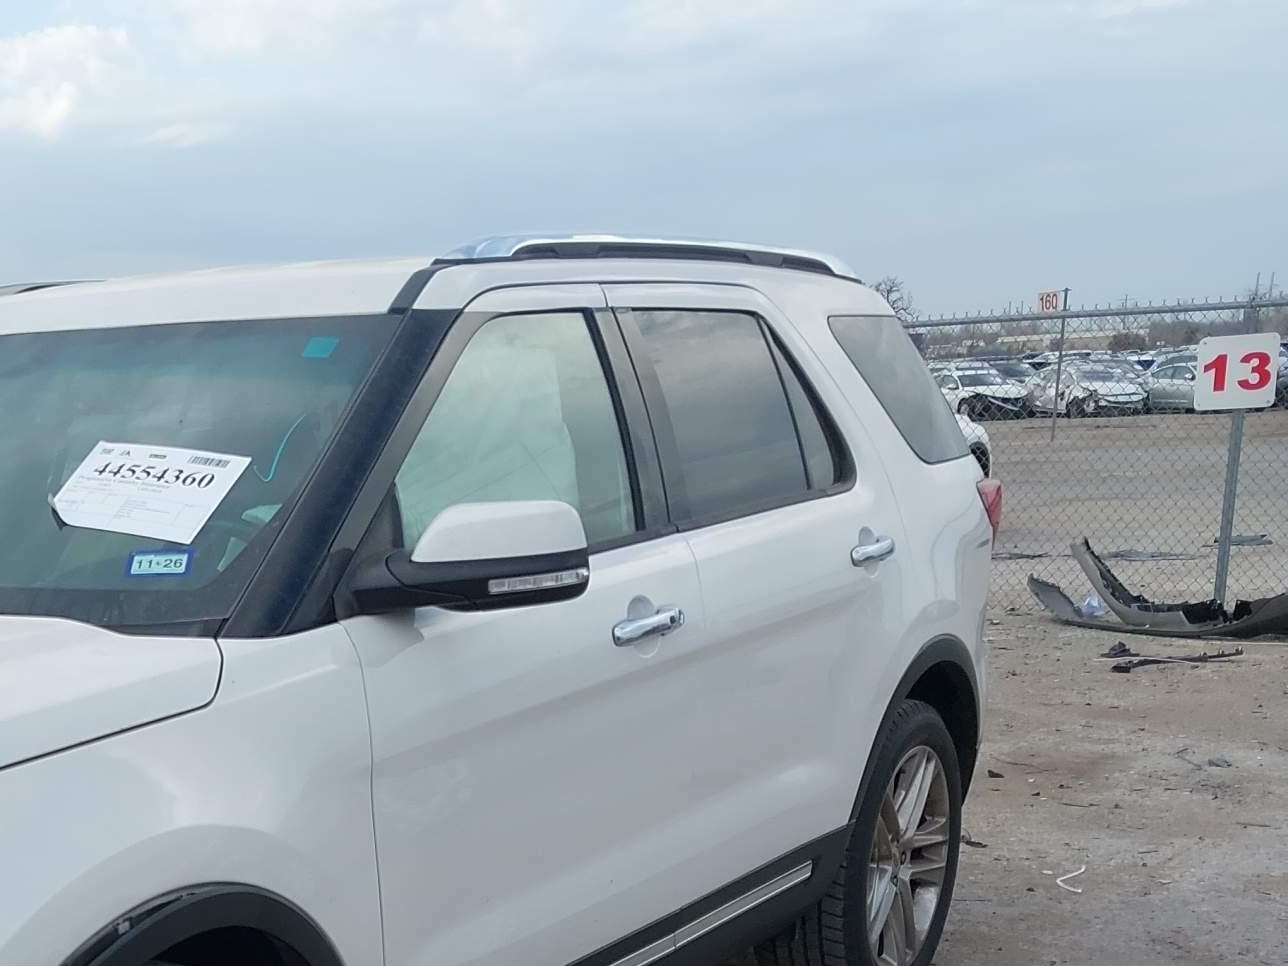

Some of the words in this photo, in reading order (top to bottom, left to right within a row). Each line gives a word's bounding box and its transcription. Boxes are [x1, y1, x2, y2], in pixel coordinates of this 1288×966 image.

[1039, 293, 1058, 312] 160
[1202, 351, 1273, 393] 13
[93, 461, 216, 489] 44554360
